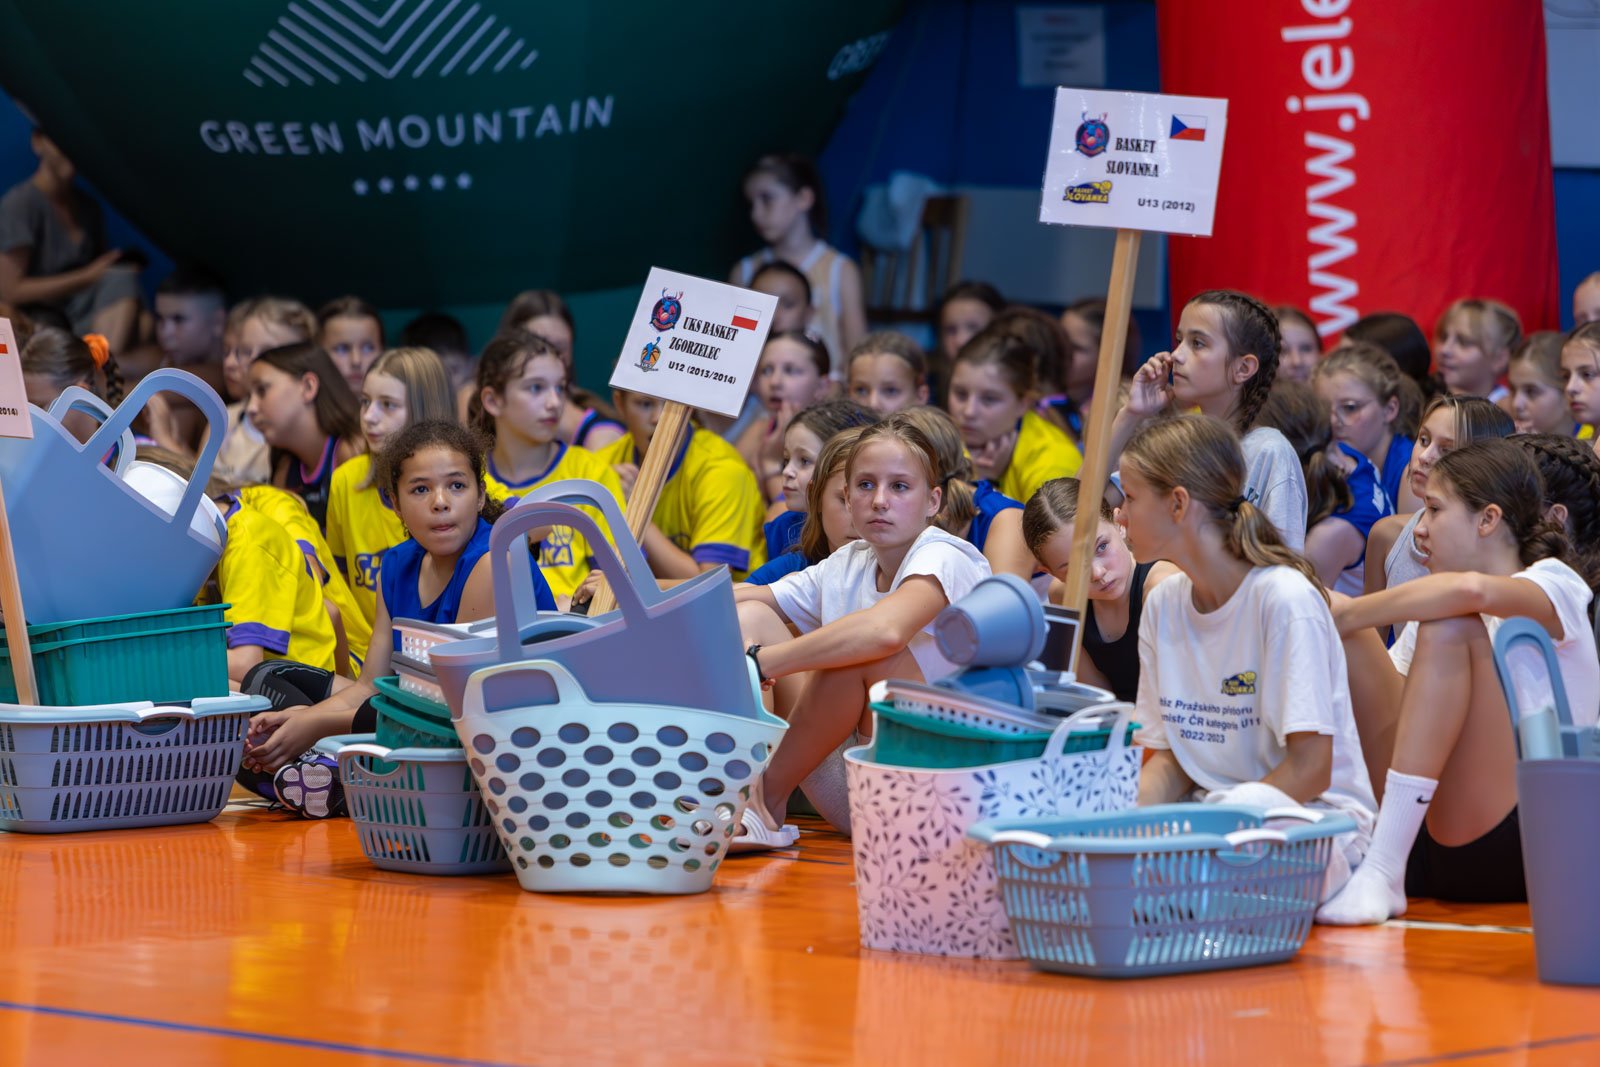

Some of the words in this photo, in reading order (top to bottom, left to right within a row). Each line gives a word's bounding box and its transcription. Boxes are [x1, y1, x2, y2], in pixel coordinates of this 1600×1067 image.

[199, 120, 344, 155] GREEN
[356, 95, 614, 152] MOUNTAIN
[1115, 137, 1157, 154] BASKET
[1106, 160, 1160, 177] SLOVANKA
[1137, 198, 1159, 208] U13
[1162, 200, 1196, 213] (2012)
[682, 316, 703, 333] UKS
[702, 321, 739, 341] BASKET
[668, 336, 721, 360] ZGORZELEC
[668, 360, 686, 372] U12
[687, 365, 736, 384] (2013/2014)
[1161, 713, 1186, 723] mistr
[1188, 713, 1205, 726] ČR
[1241, 716, 1261, 728] U11
